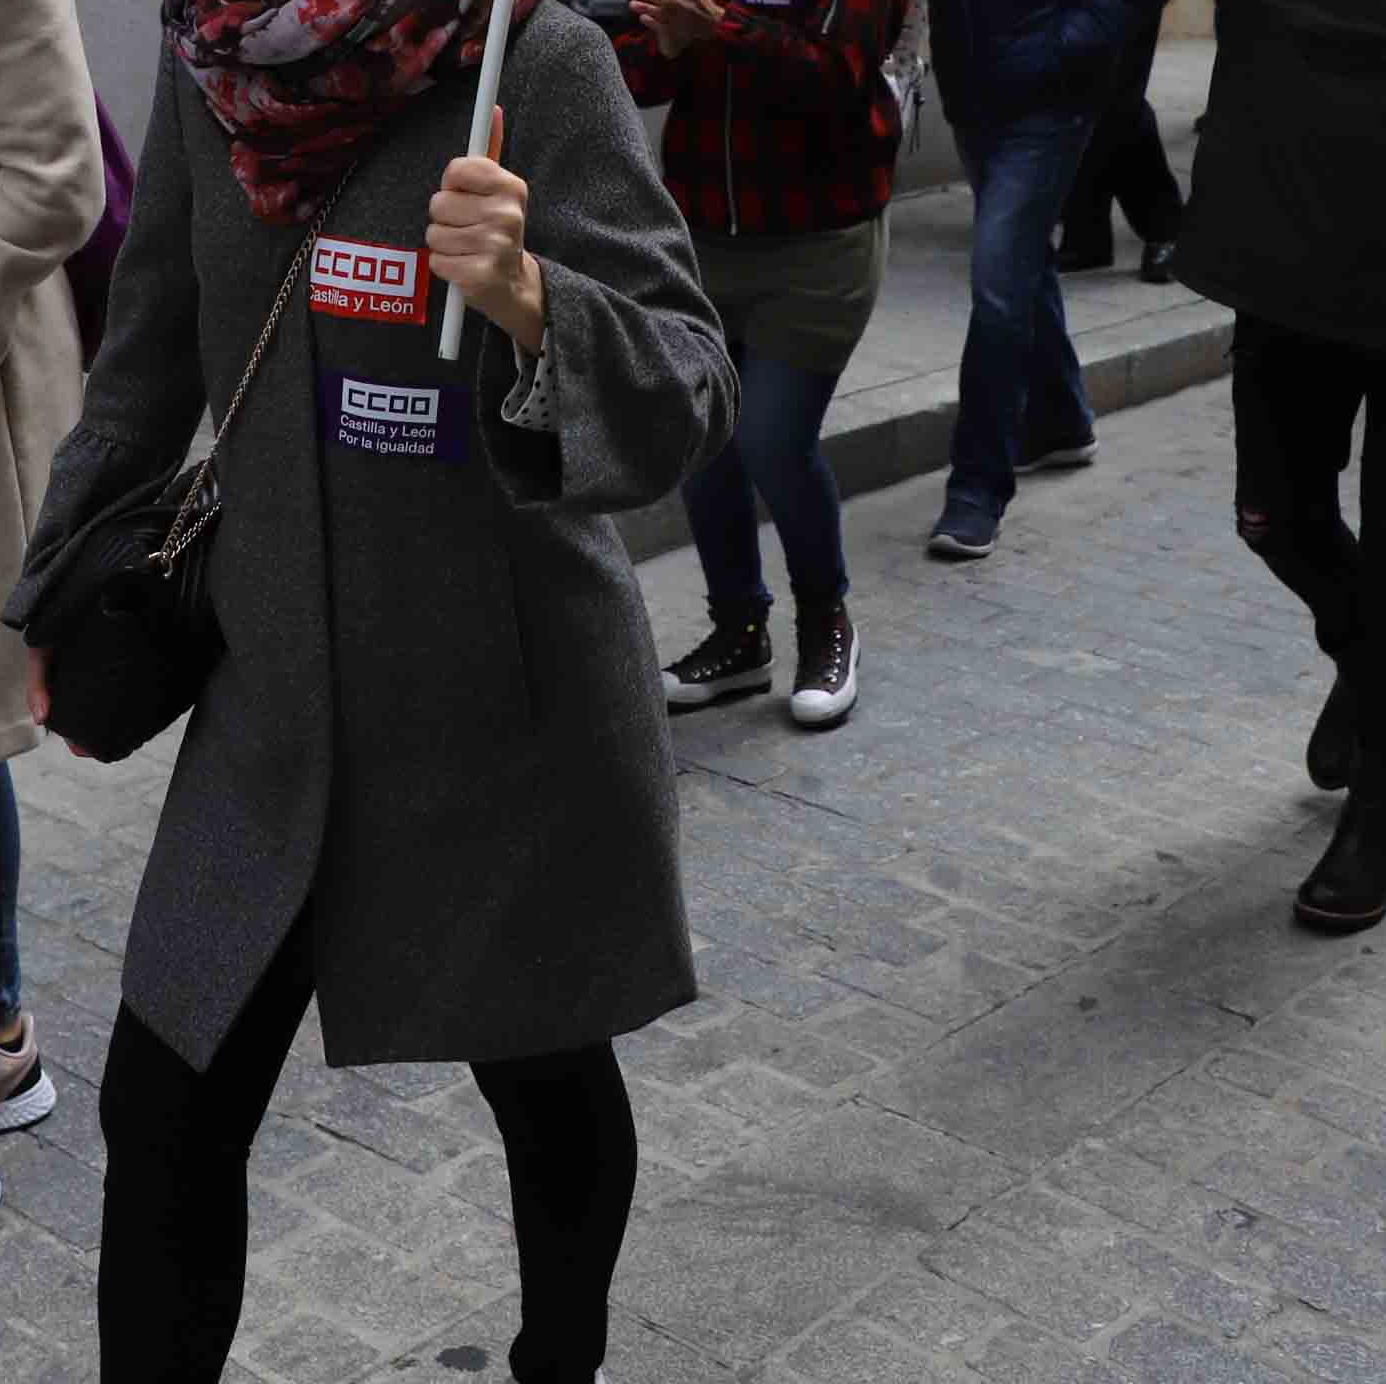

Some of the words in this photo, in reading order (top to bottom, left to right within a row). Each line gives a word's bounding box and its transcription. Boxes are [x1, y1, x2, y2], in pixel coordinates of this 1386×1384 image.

[315, 248, 407, 287] CCOO
[352, 296, 364, 313] y
[369, 296, 414, 315] León
[347, 387, 432, 416] CCOO
[339, 414, 387, 436] Castilla
[389, 427, 400, 440] y
[401, 423, 437, 439] León
[338, 430, 359, 447] Por
[361, 433, 374, 450] la
[375, 433, 436, 456] igualdad
